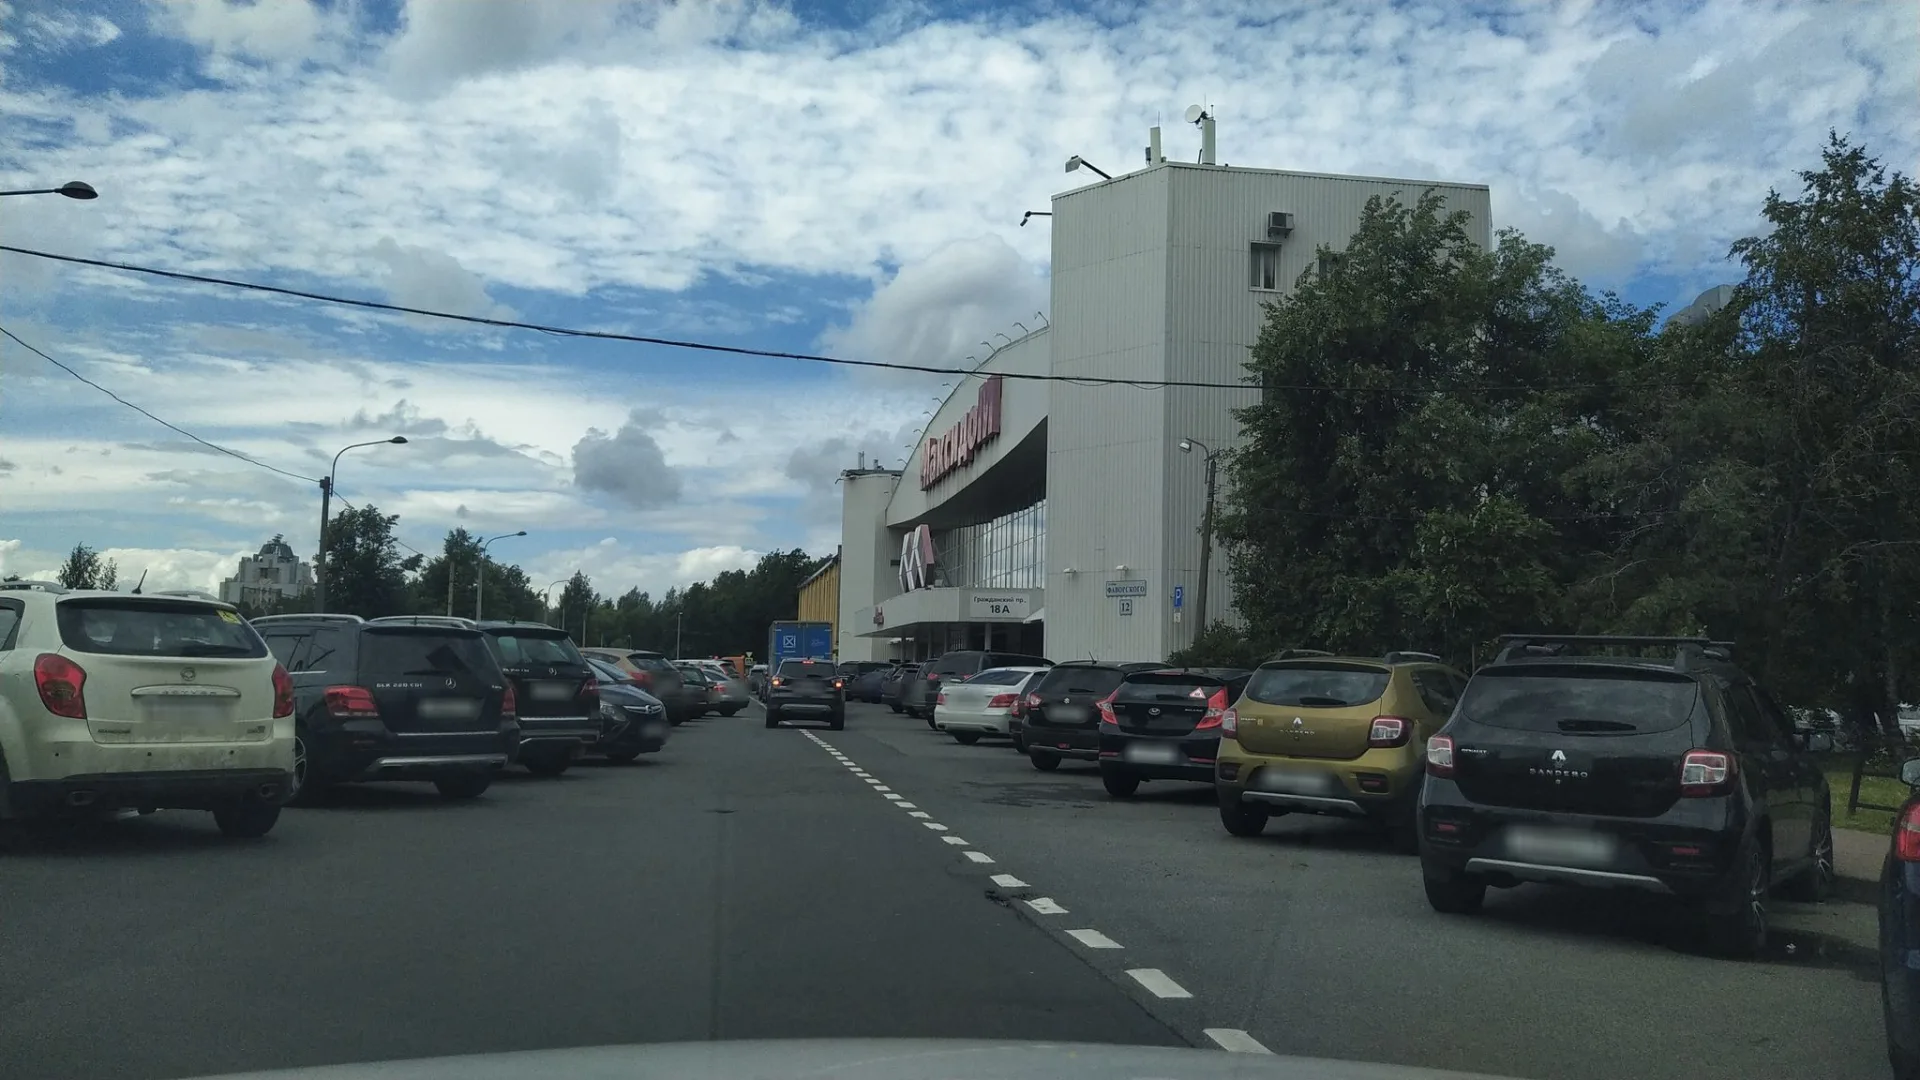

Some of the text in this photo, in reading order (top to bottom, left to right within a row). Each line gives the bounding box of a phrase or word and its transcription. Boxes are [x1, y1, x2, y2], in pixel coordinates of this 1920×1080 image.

[973, 596, 1014, 605] Гражданский
[1121, 602, 1130, 612] 12
[1529, 768, 1589, 778] SANDERO
